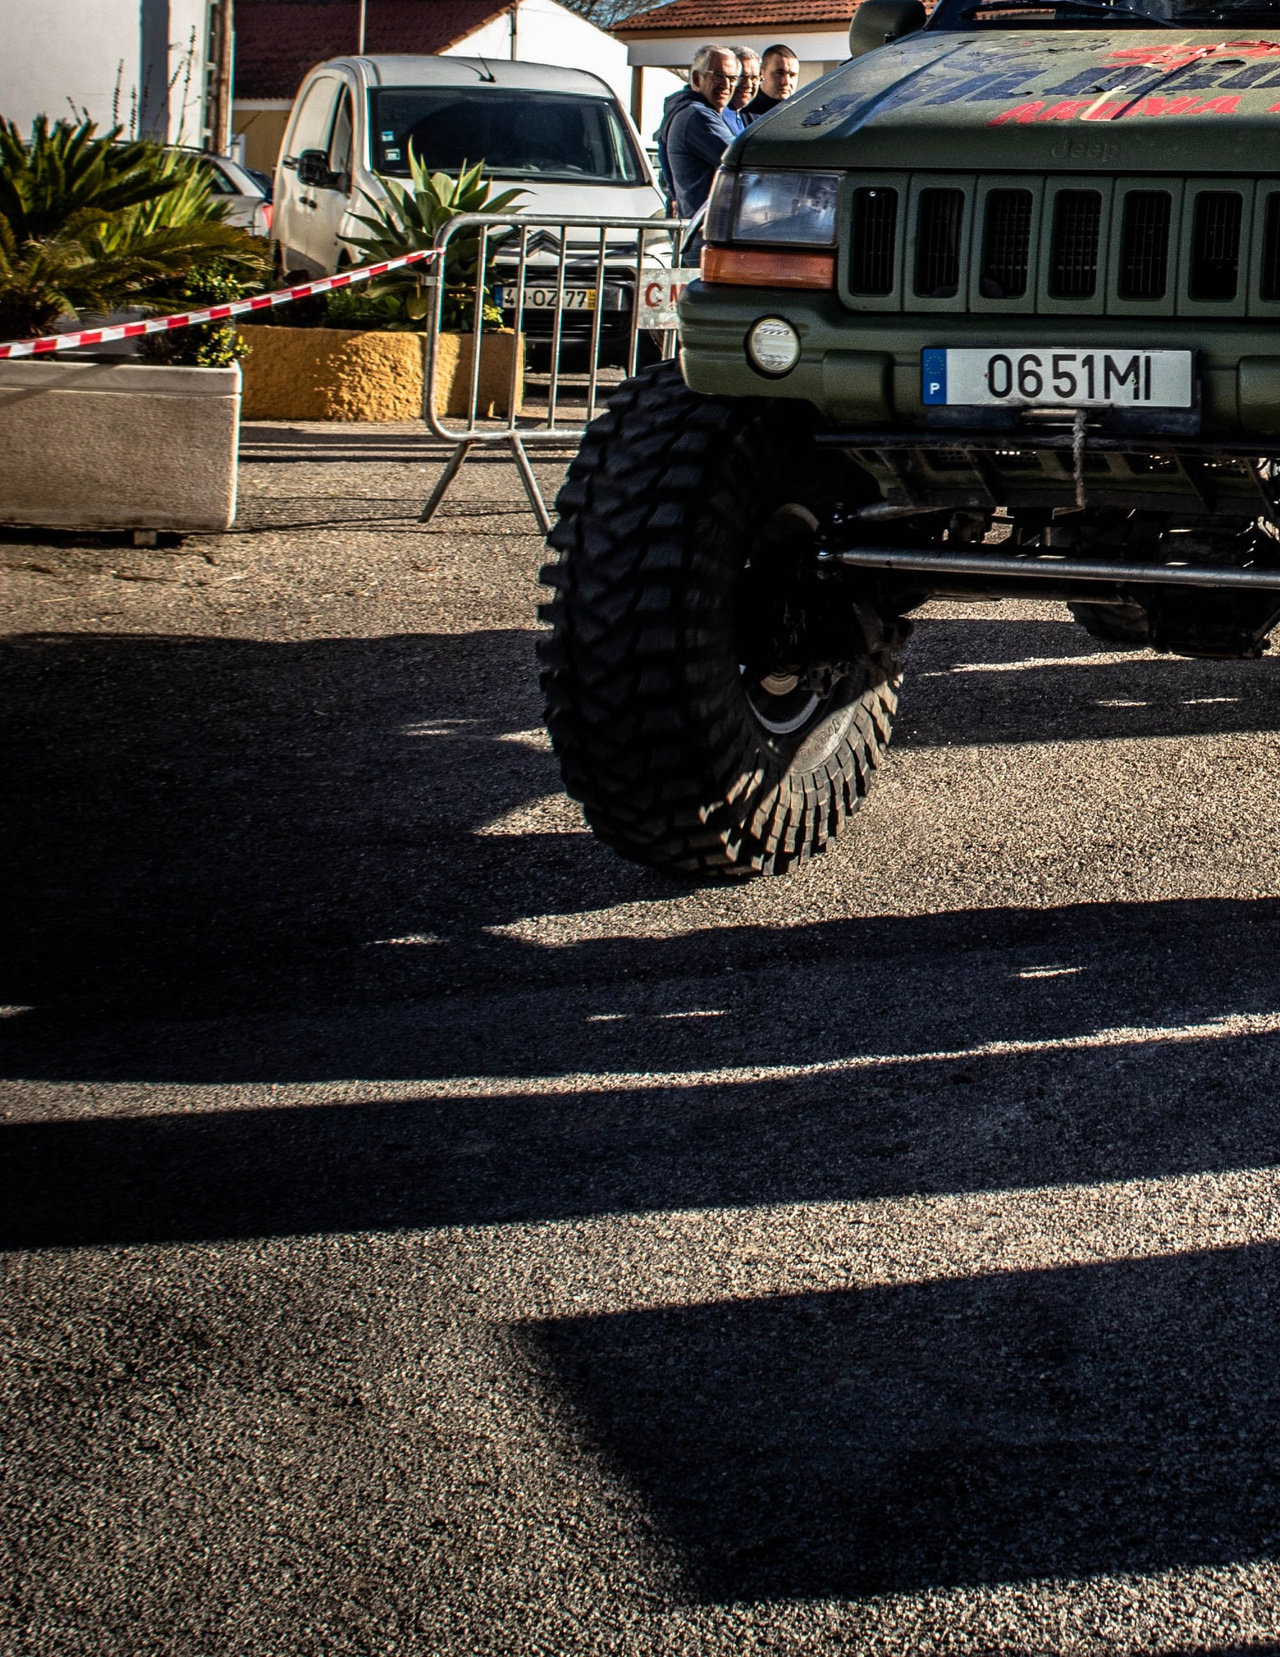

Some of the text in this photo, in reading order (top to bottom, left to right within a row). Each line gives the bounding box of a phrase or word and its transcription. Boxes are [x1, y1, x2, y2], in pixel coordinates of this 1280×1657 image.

[986, 94, 1243, 128] AKUMA
[1051, 137, 1119, 162] Jeep
[645, 282, 664, 308] C
[930, 382, 940, 395] P
